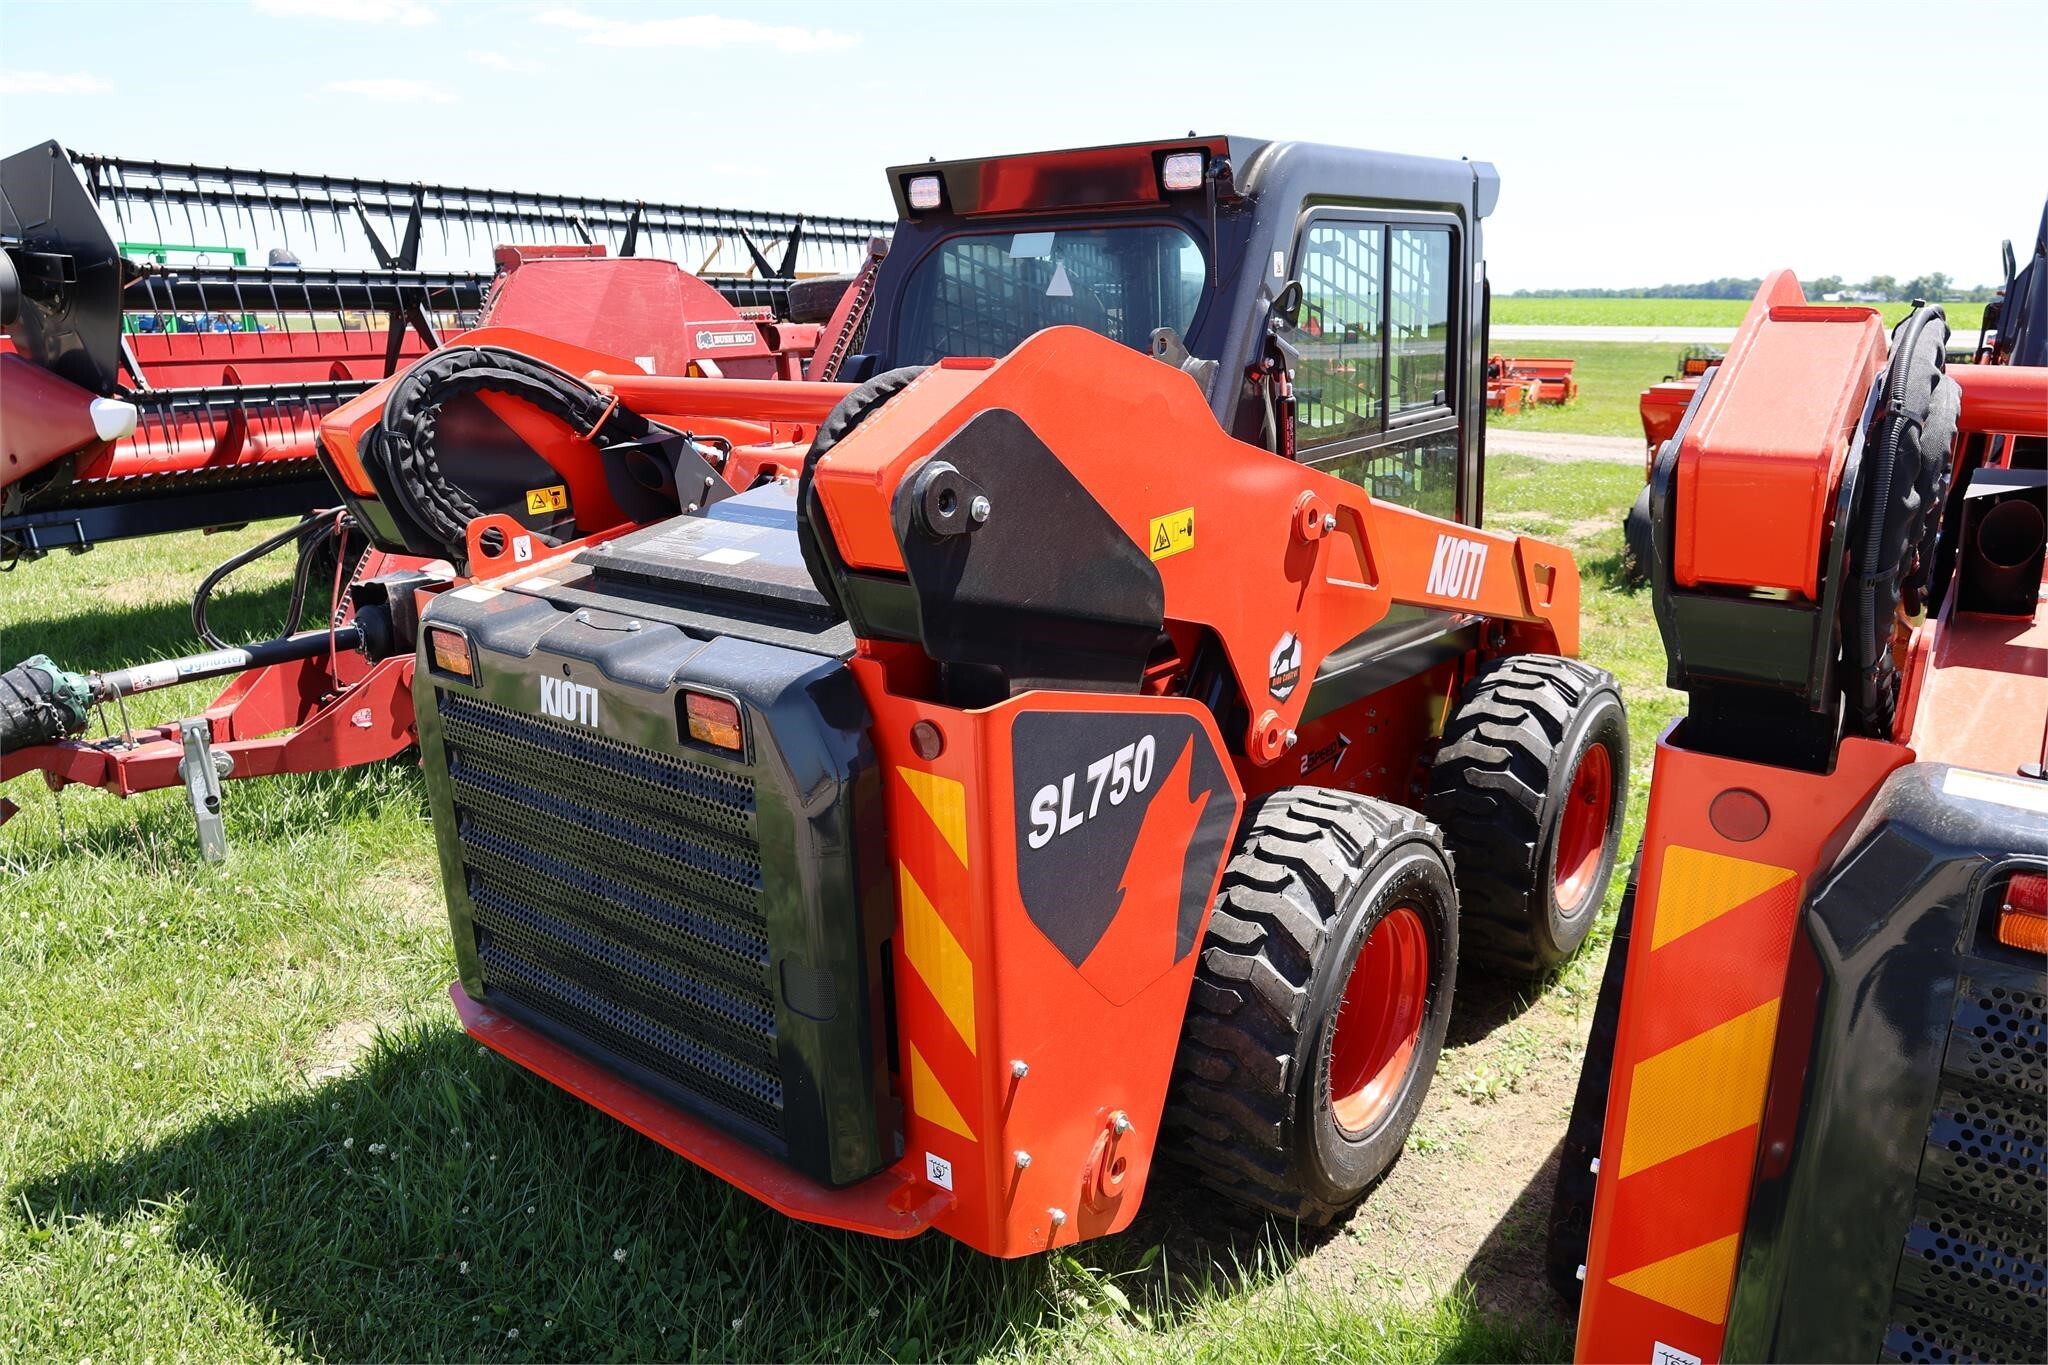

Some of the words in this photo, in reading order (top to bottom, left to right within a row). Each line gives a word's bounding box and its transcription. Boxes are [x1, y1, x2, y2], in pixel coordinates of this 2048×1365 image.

[713, 335, 734, 344] BUSH
[735, 333, 753, 343] HOG
[1426, 534, 1488, 600] KIOTI
[1272, 675, 1282, 686] Ride
[1282, 667, 1299, 682] Control
[541, 675, 598, 728] KIOTI
